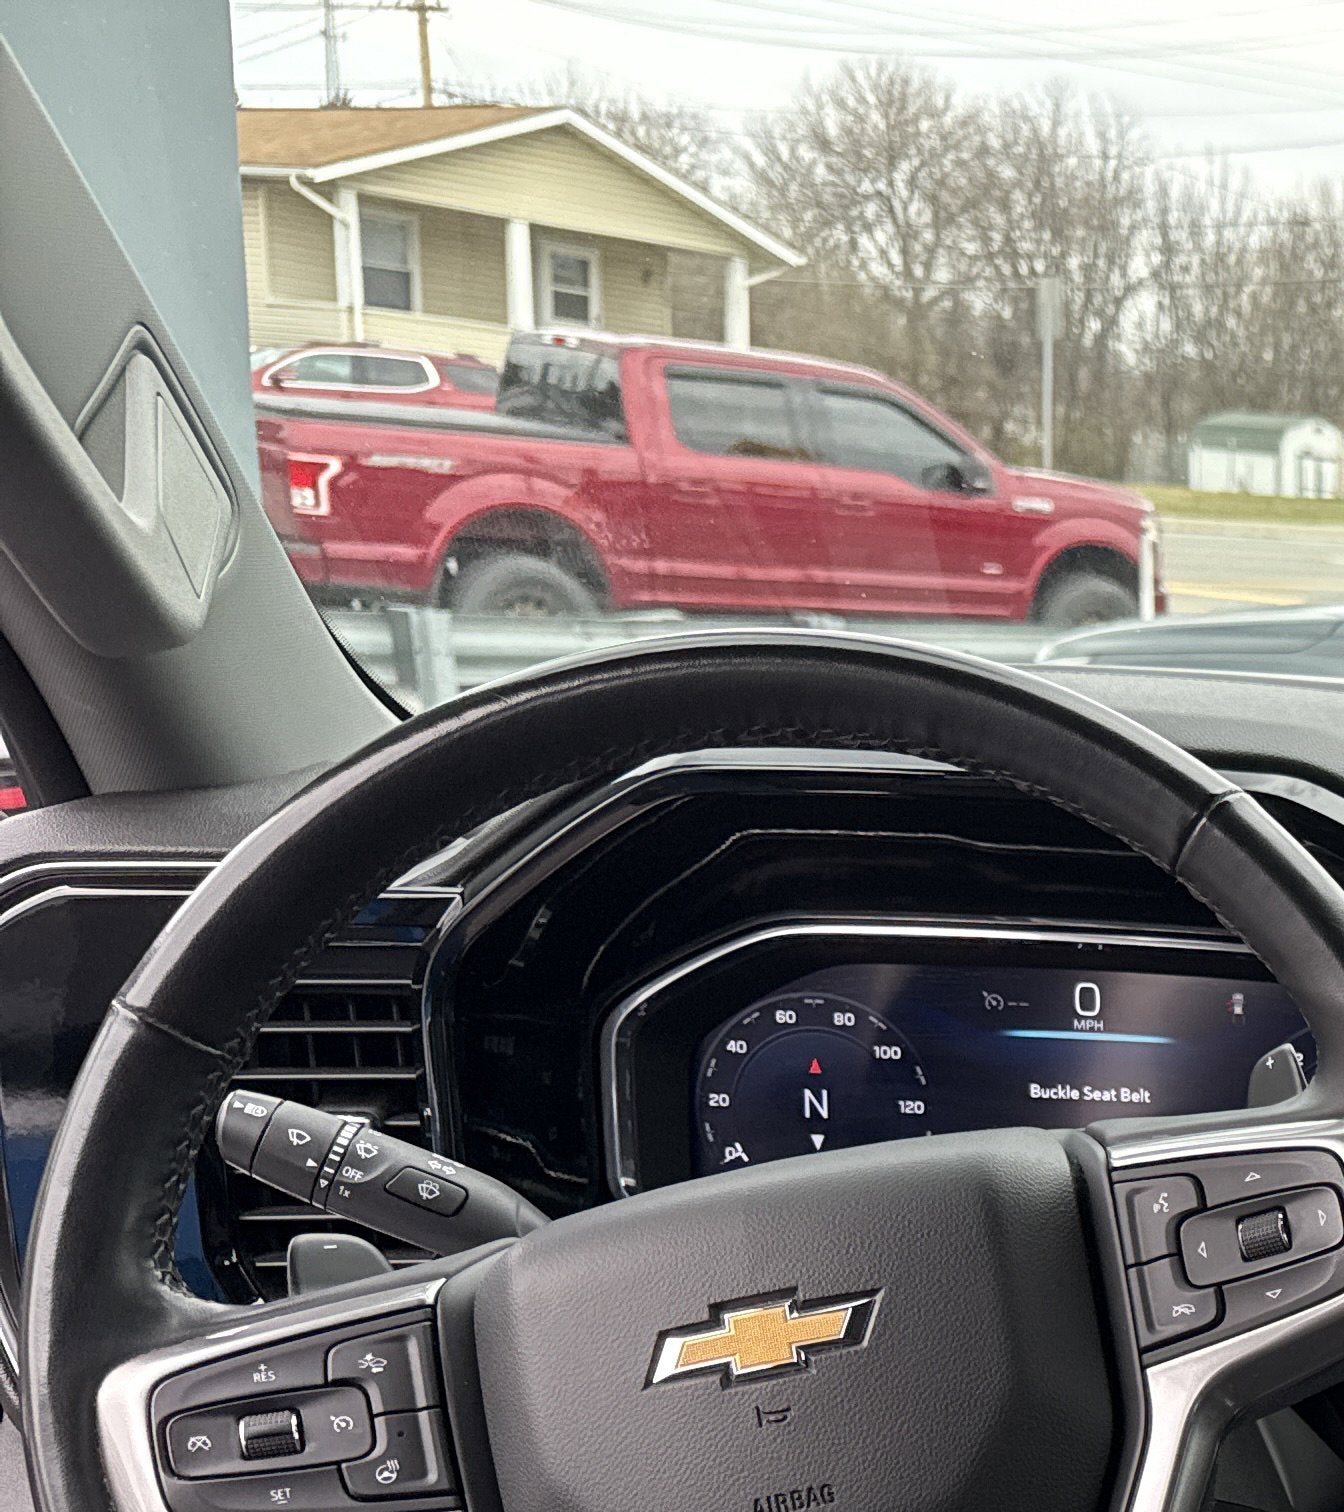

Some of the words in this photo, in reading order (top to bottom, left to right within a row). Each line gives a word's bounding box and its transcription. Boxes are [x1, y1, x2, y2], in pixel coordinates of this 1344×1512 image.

[1074, 981, 1101, 1017] 0
[775, 1010, 797, 1024] 60
[833, 1012, 855, 1026] 80
[1073, 1019, 1104, 1031] MPH
[726, 1040, 748, 1054] 40
[873, 1046, 902, 1060] 100
[708, 1094, 730, 1107] 20
[1029, 1083, 1080, 1101] Buckle
[1083, 1085, 1117, 1102] Seat
[1120, 1087, 1151, 1104] Belt
[803, 1088, 829, 1119] N
[898, 1100, 925, 1115] 120
[342, 1166, 364, 1182] OFF
[253, 1370, 276, 1383] RES
[270, 1487, 291, 1501] SET
